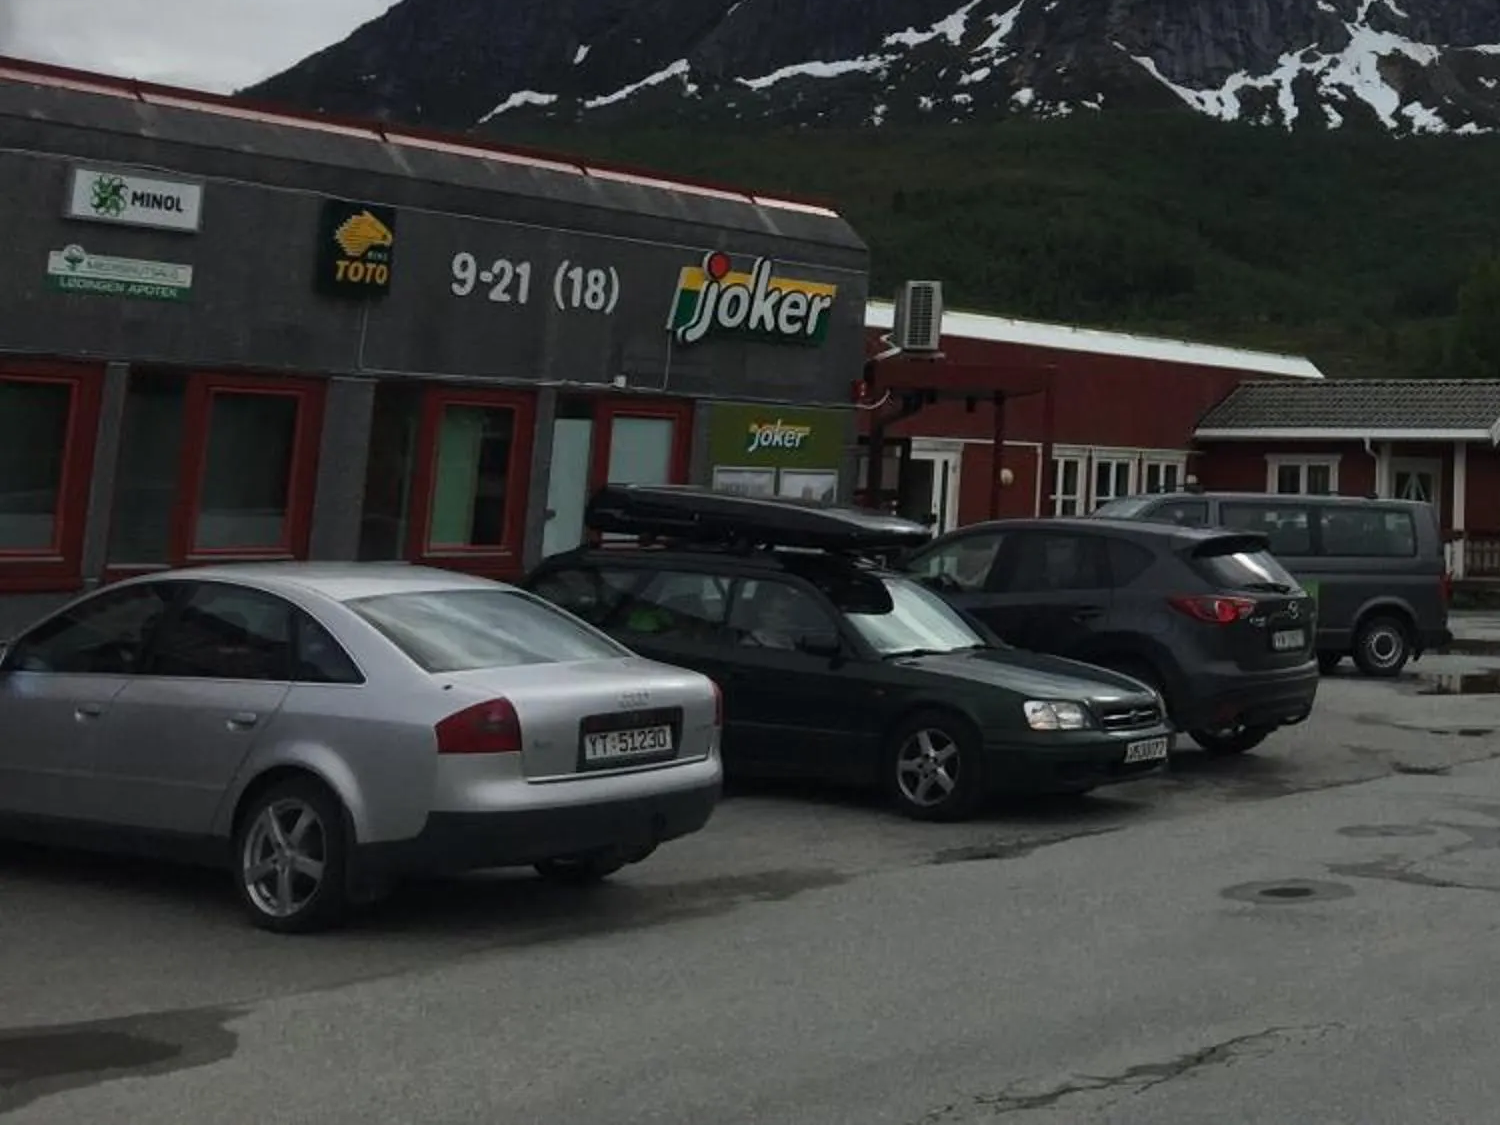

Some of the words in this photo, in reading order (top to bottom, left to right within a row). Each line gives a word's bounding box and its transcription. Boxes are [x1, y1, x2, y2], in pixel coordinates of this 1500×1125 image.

[130, 190, 184, 213] MINOL
[335, 260, 389, 285] TOTO
[451, 251, 531, 305] 9-21
[553, 259, 620, 314] (18)
[675, 250, 832, 343] joker
[748, 418, 808, 452] joker
[619, 728, 667, 752] 51230
